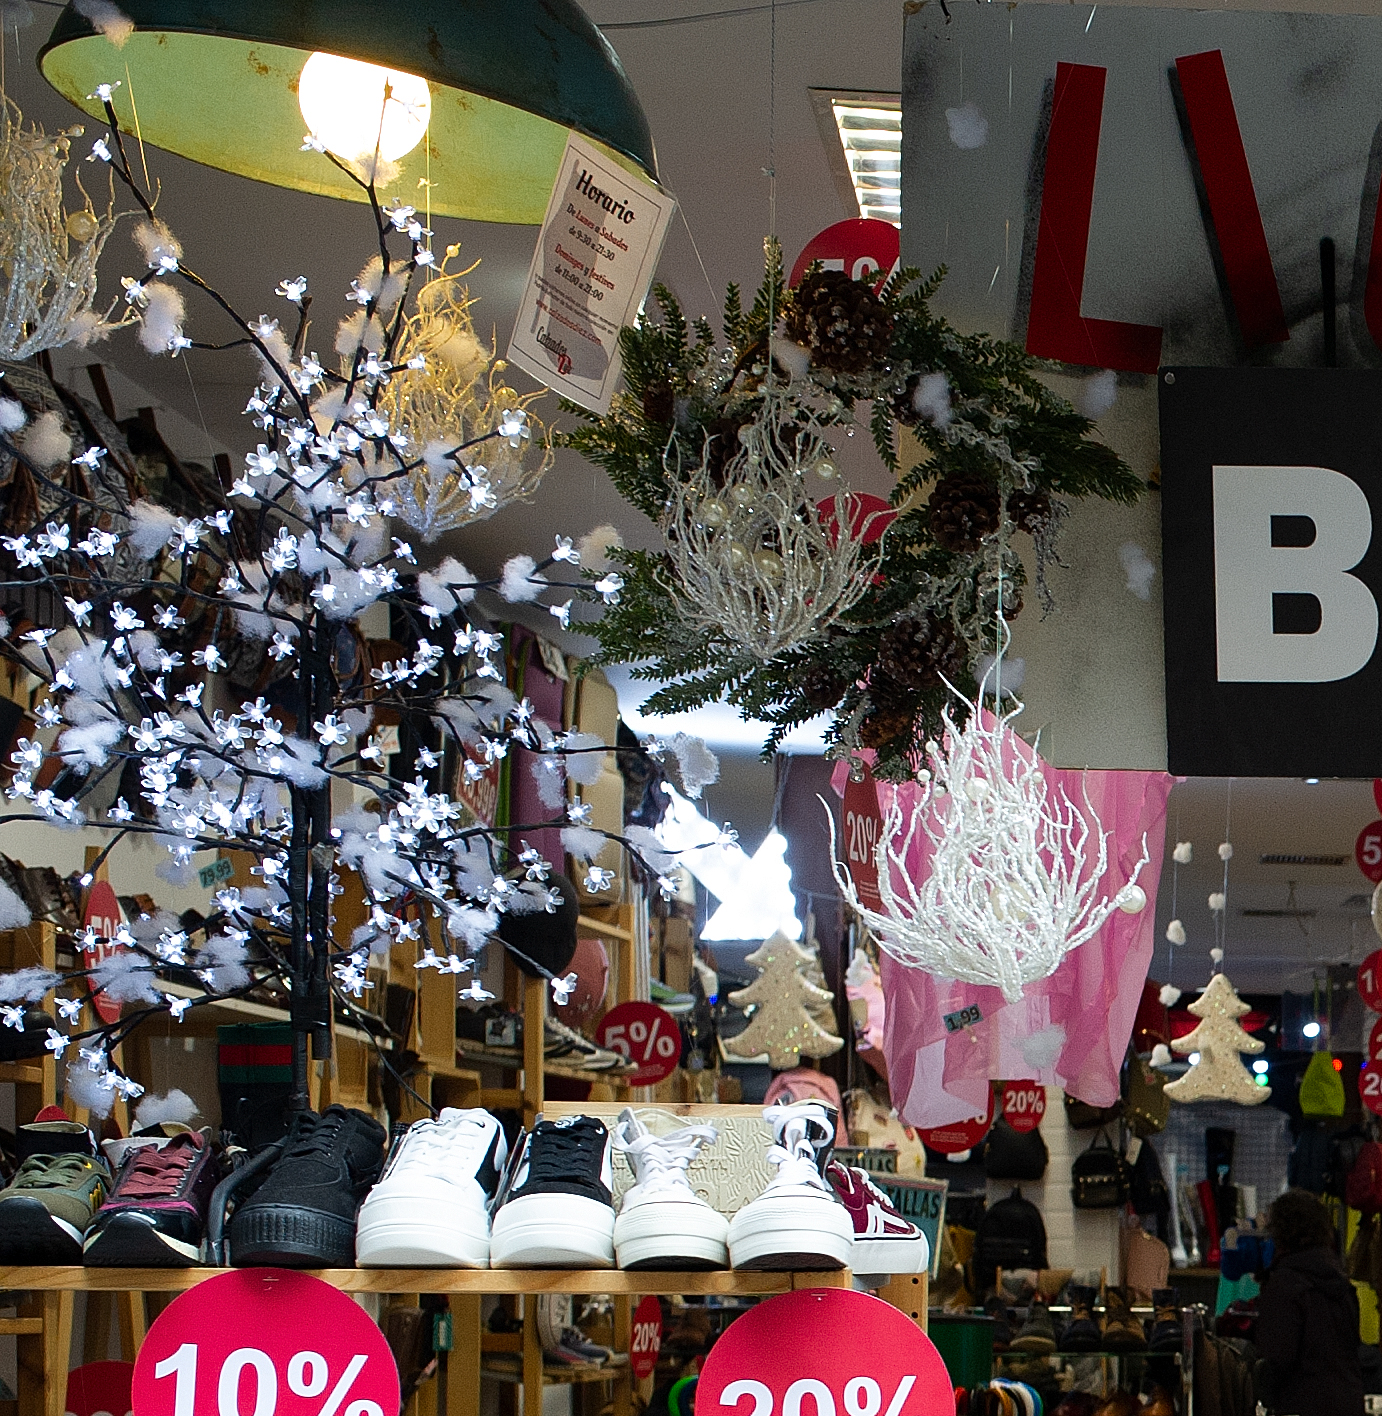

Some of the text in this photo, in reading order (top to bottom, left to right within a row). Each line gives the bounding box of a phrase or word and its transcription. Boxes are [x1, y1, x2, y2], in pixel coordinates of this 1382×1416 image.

[575, 169, 636, 225] Horario
[603, 1018, 675, 1061] 5%
[1006, 1091, 1043, 1112] 20%
[633, 1323, 660, 1352] 20%
